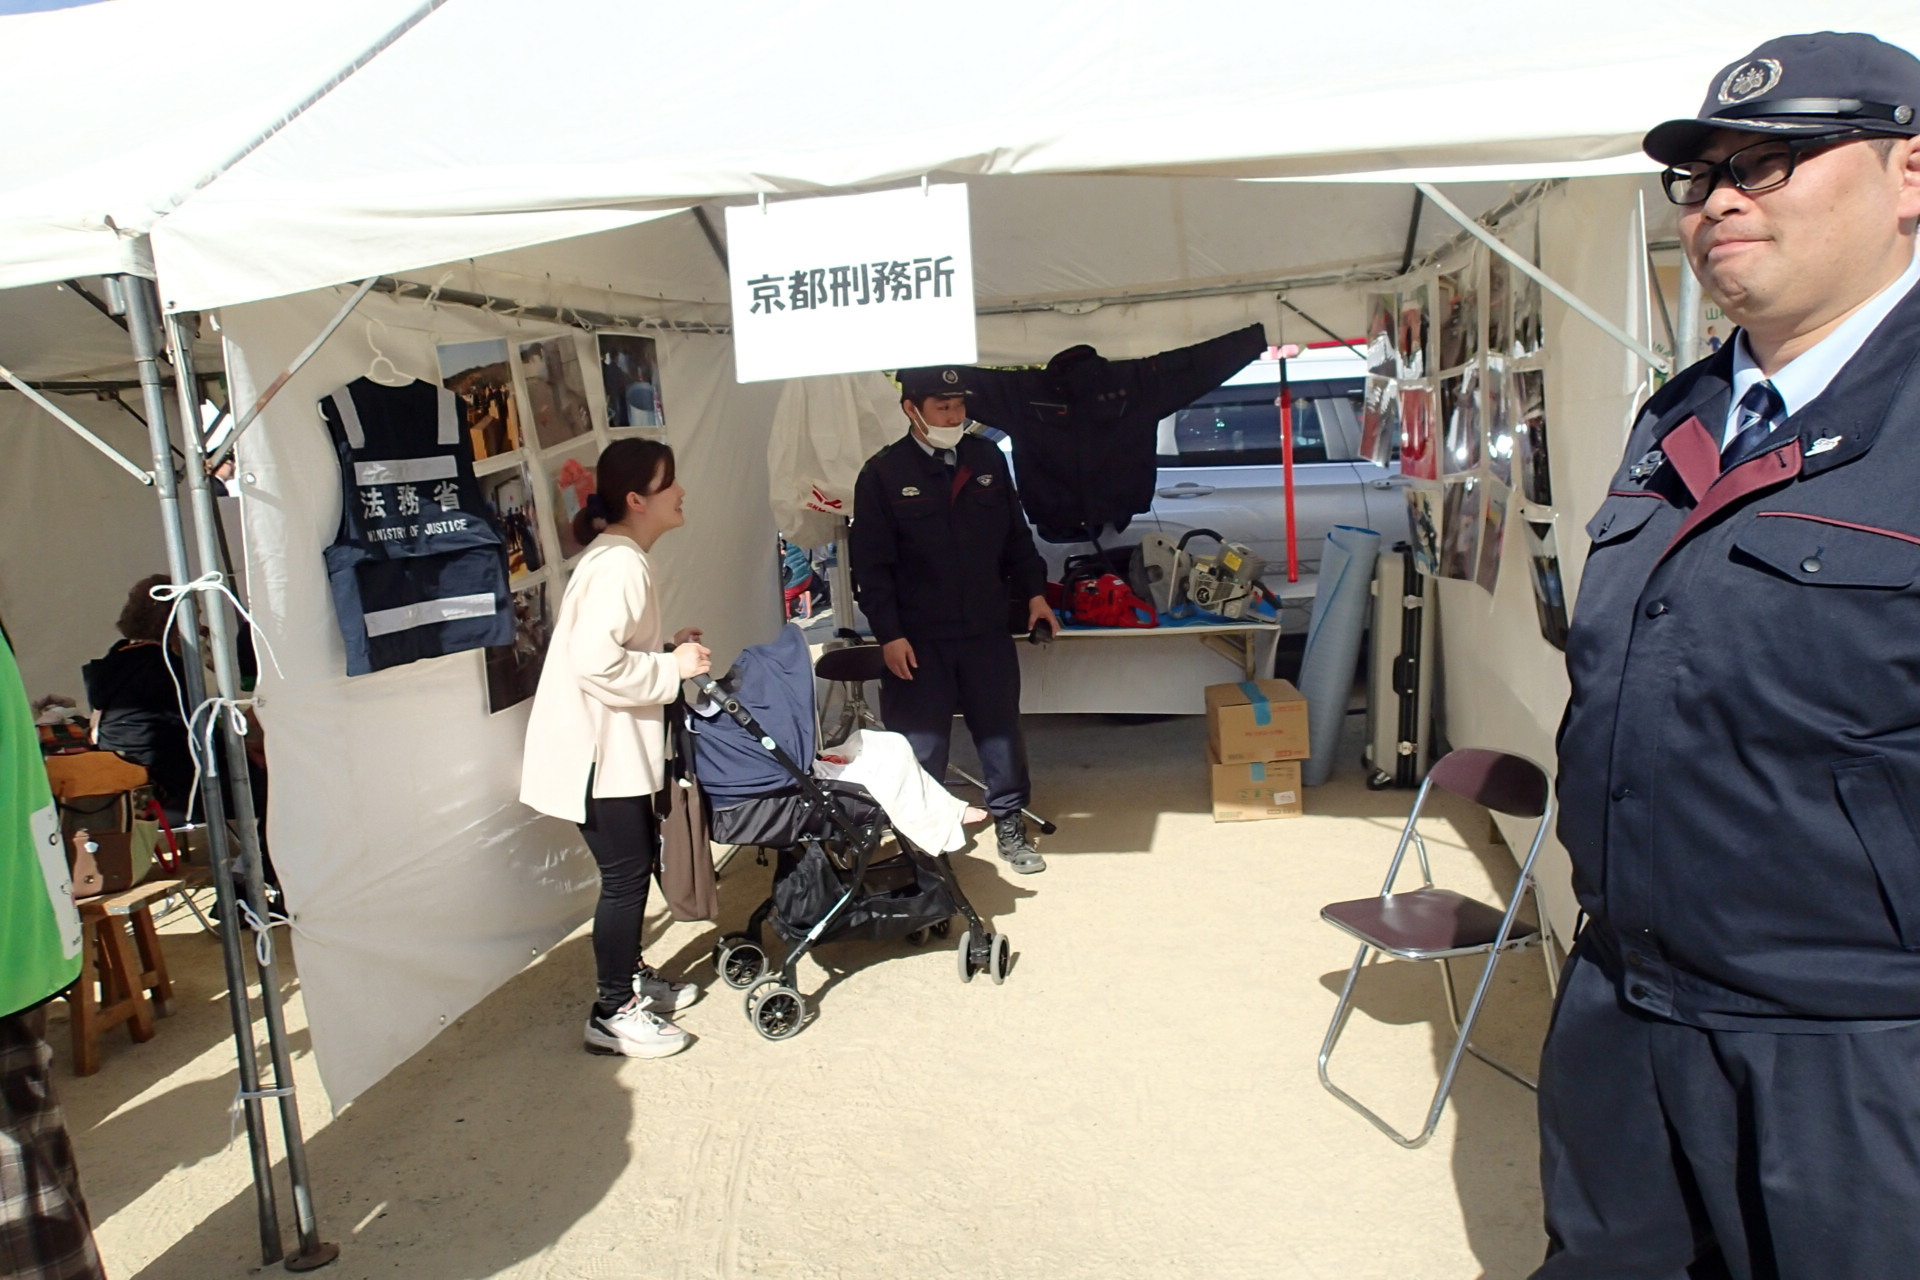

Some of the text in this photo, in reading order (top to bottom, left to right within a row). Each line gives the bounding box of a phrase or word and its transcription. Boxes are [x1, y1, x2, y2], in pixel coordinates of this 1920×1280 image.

[747, 255, 955, 314] 京都刑務所
[360, 481, 460, 519] 法務省
[366, 519, 468, 542] MINISTRY OF JUSTICE
